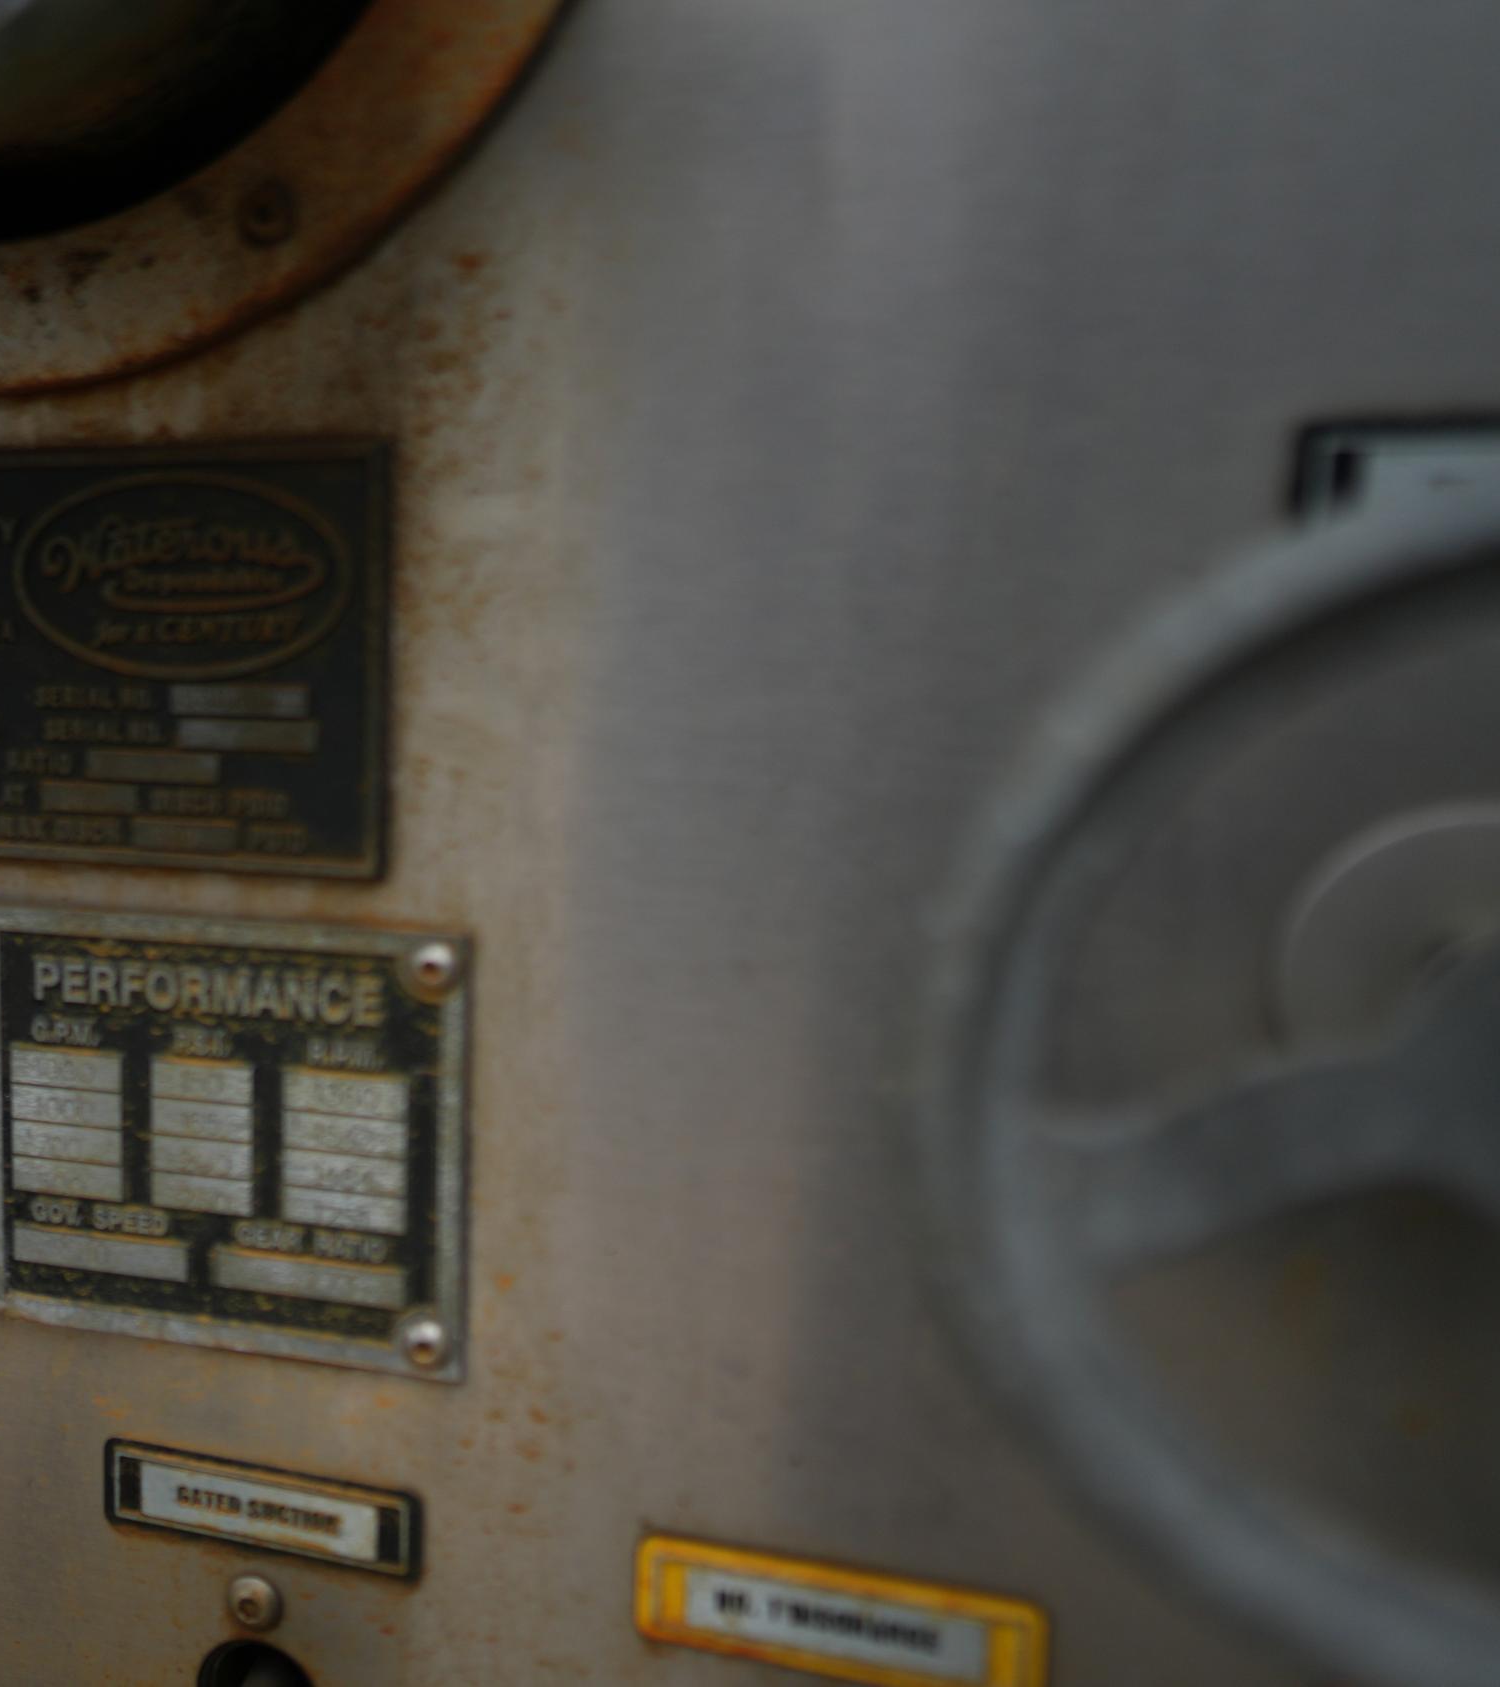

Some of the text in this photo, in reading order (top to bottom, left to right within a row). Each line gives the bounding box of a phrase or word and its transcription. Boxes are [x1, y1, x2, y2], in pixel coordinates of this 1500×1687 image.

[33, 956, 386, 1029] PERFORMANCE
[92, 1203, 170, 1237] SPEED
[176, 1484, 241, 1515] GATED
